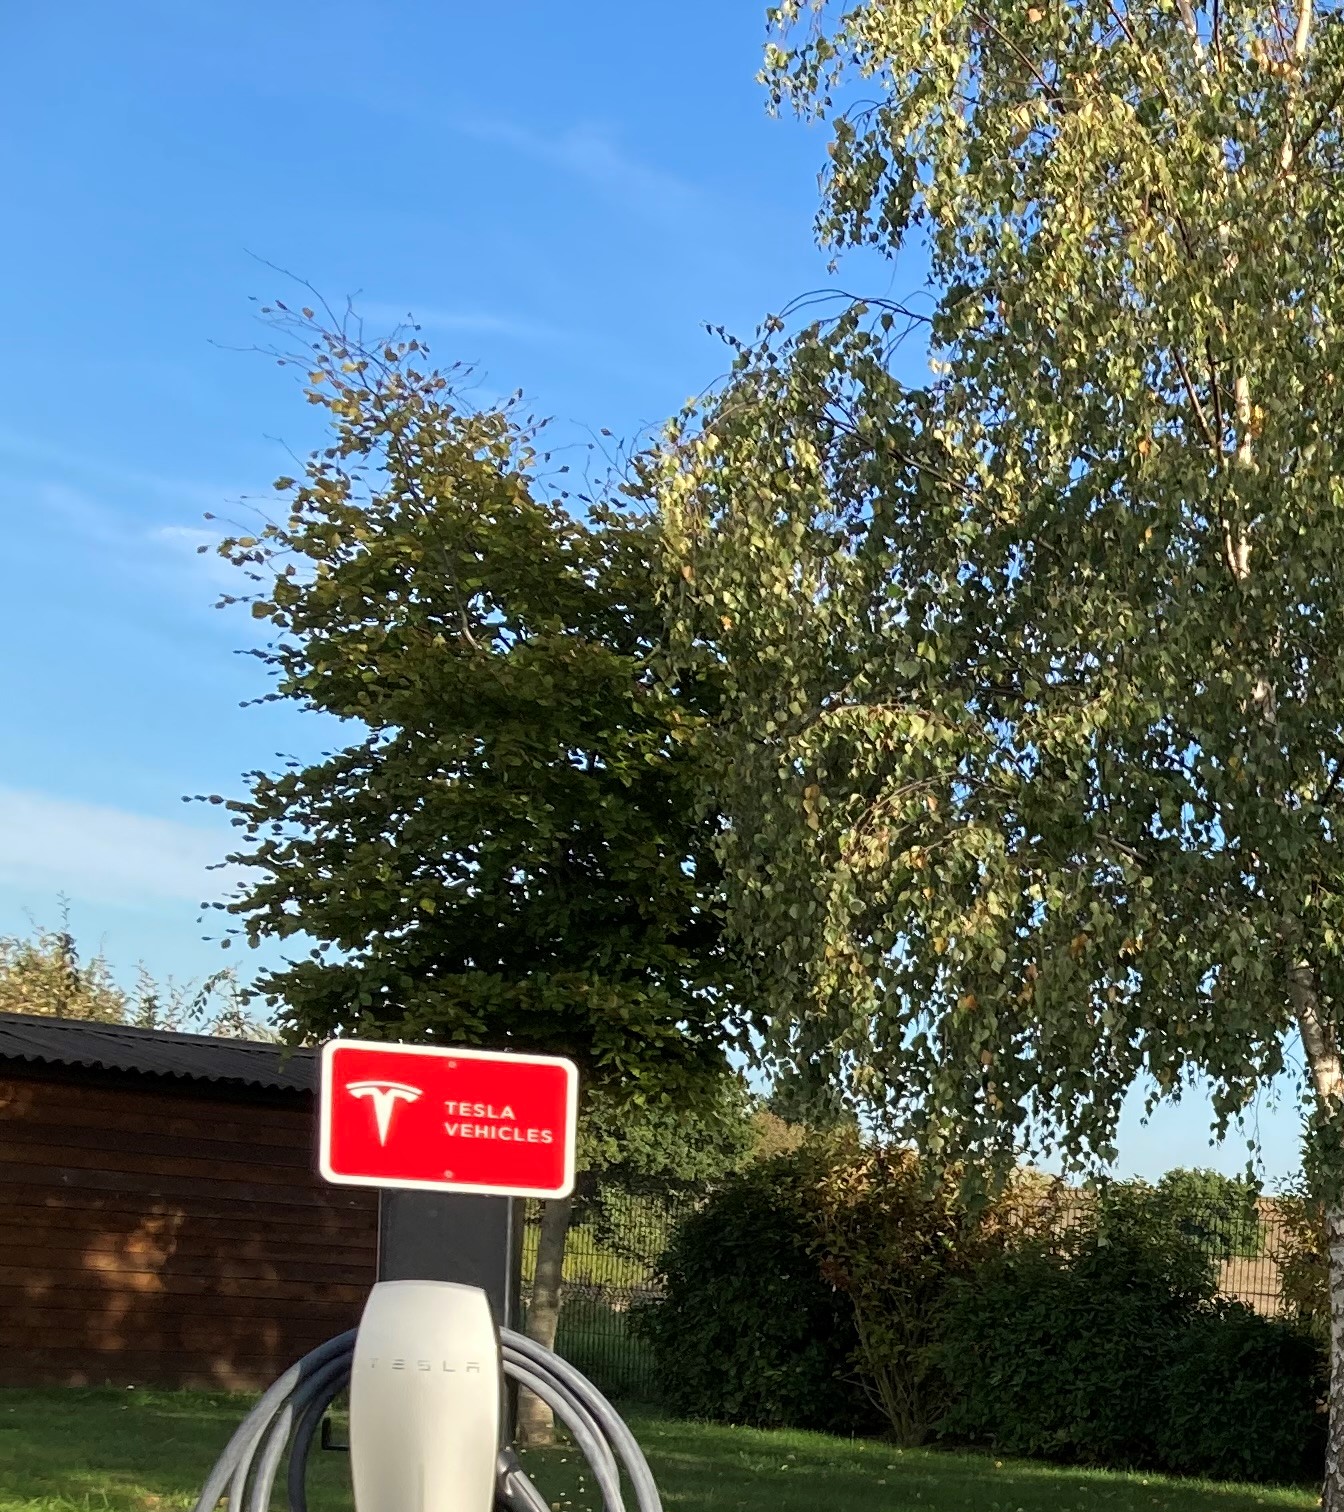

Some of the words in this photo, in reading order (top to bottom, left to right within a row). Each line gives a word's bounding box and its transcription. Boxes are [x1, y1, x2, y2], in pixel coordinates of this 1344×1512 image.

[444, 1100, 516, 1120] TESLA
[444, 1121, 554, 1144] VEHICLES
[368, 1356, 481, 1374] TESLA
